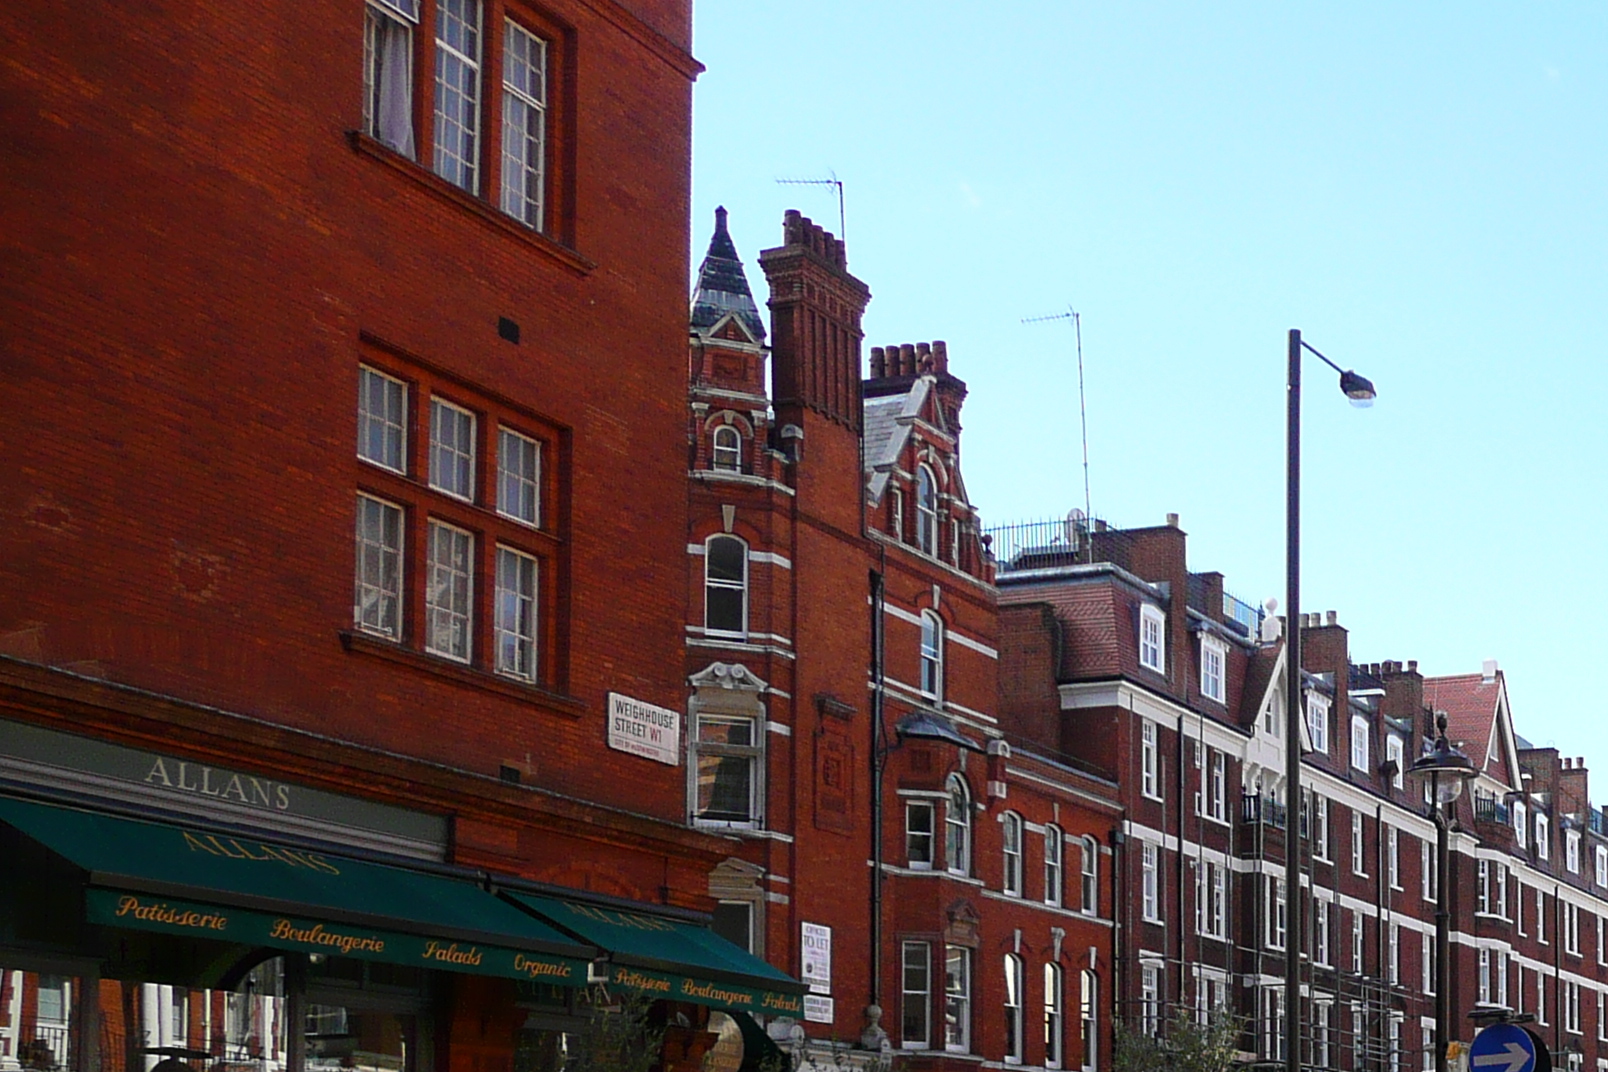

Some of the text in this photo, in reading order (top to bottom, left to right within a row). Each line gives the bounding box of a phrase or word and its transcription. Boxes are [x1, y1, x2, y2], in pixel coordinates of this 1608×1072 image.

[614, 717, 662, 743] STREET W1
[615, 699, 674, 730] WEIGHHOUSE
[144, 756, 290, 810] ALLANS
[183, 831, 341, 876] ALLANS
[115, 895, 572, 978] Patisserie Boulangerie Salads Organic
[804, 935, 828, 951] TO LET
